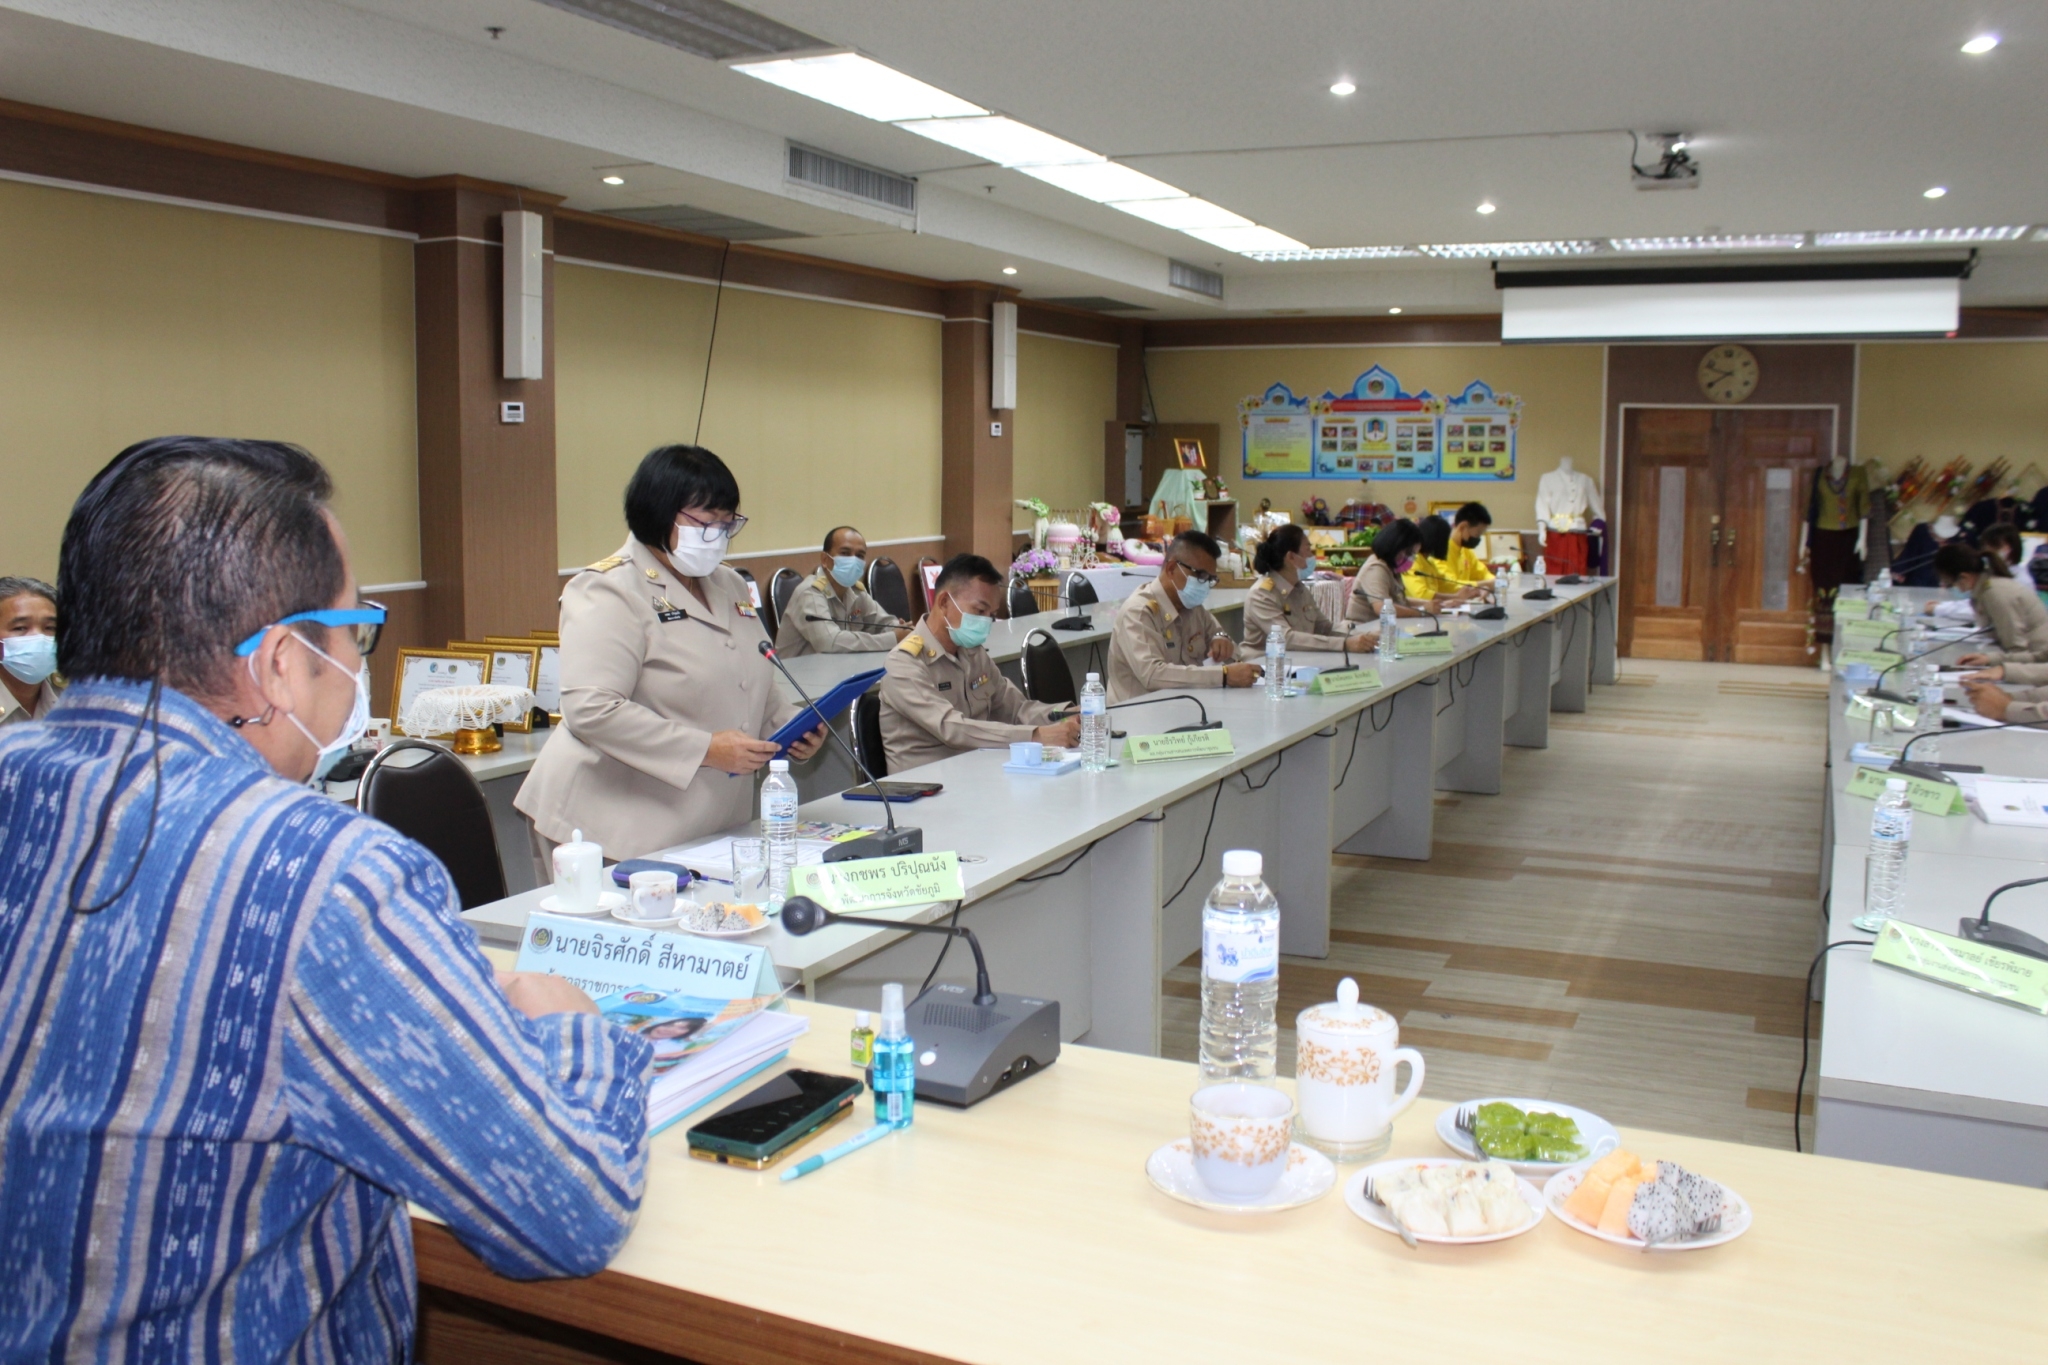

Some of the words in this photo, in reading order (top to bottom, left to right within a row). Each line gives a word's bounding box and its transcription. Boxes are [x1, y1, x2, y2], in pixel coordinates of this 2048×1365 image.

[555, 933, 656, 967] นายจิรศักดิ์
[657, 944, 753, 981] สีหามาตย์
